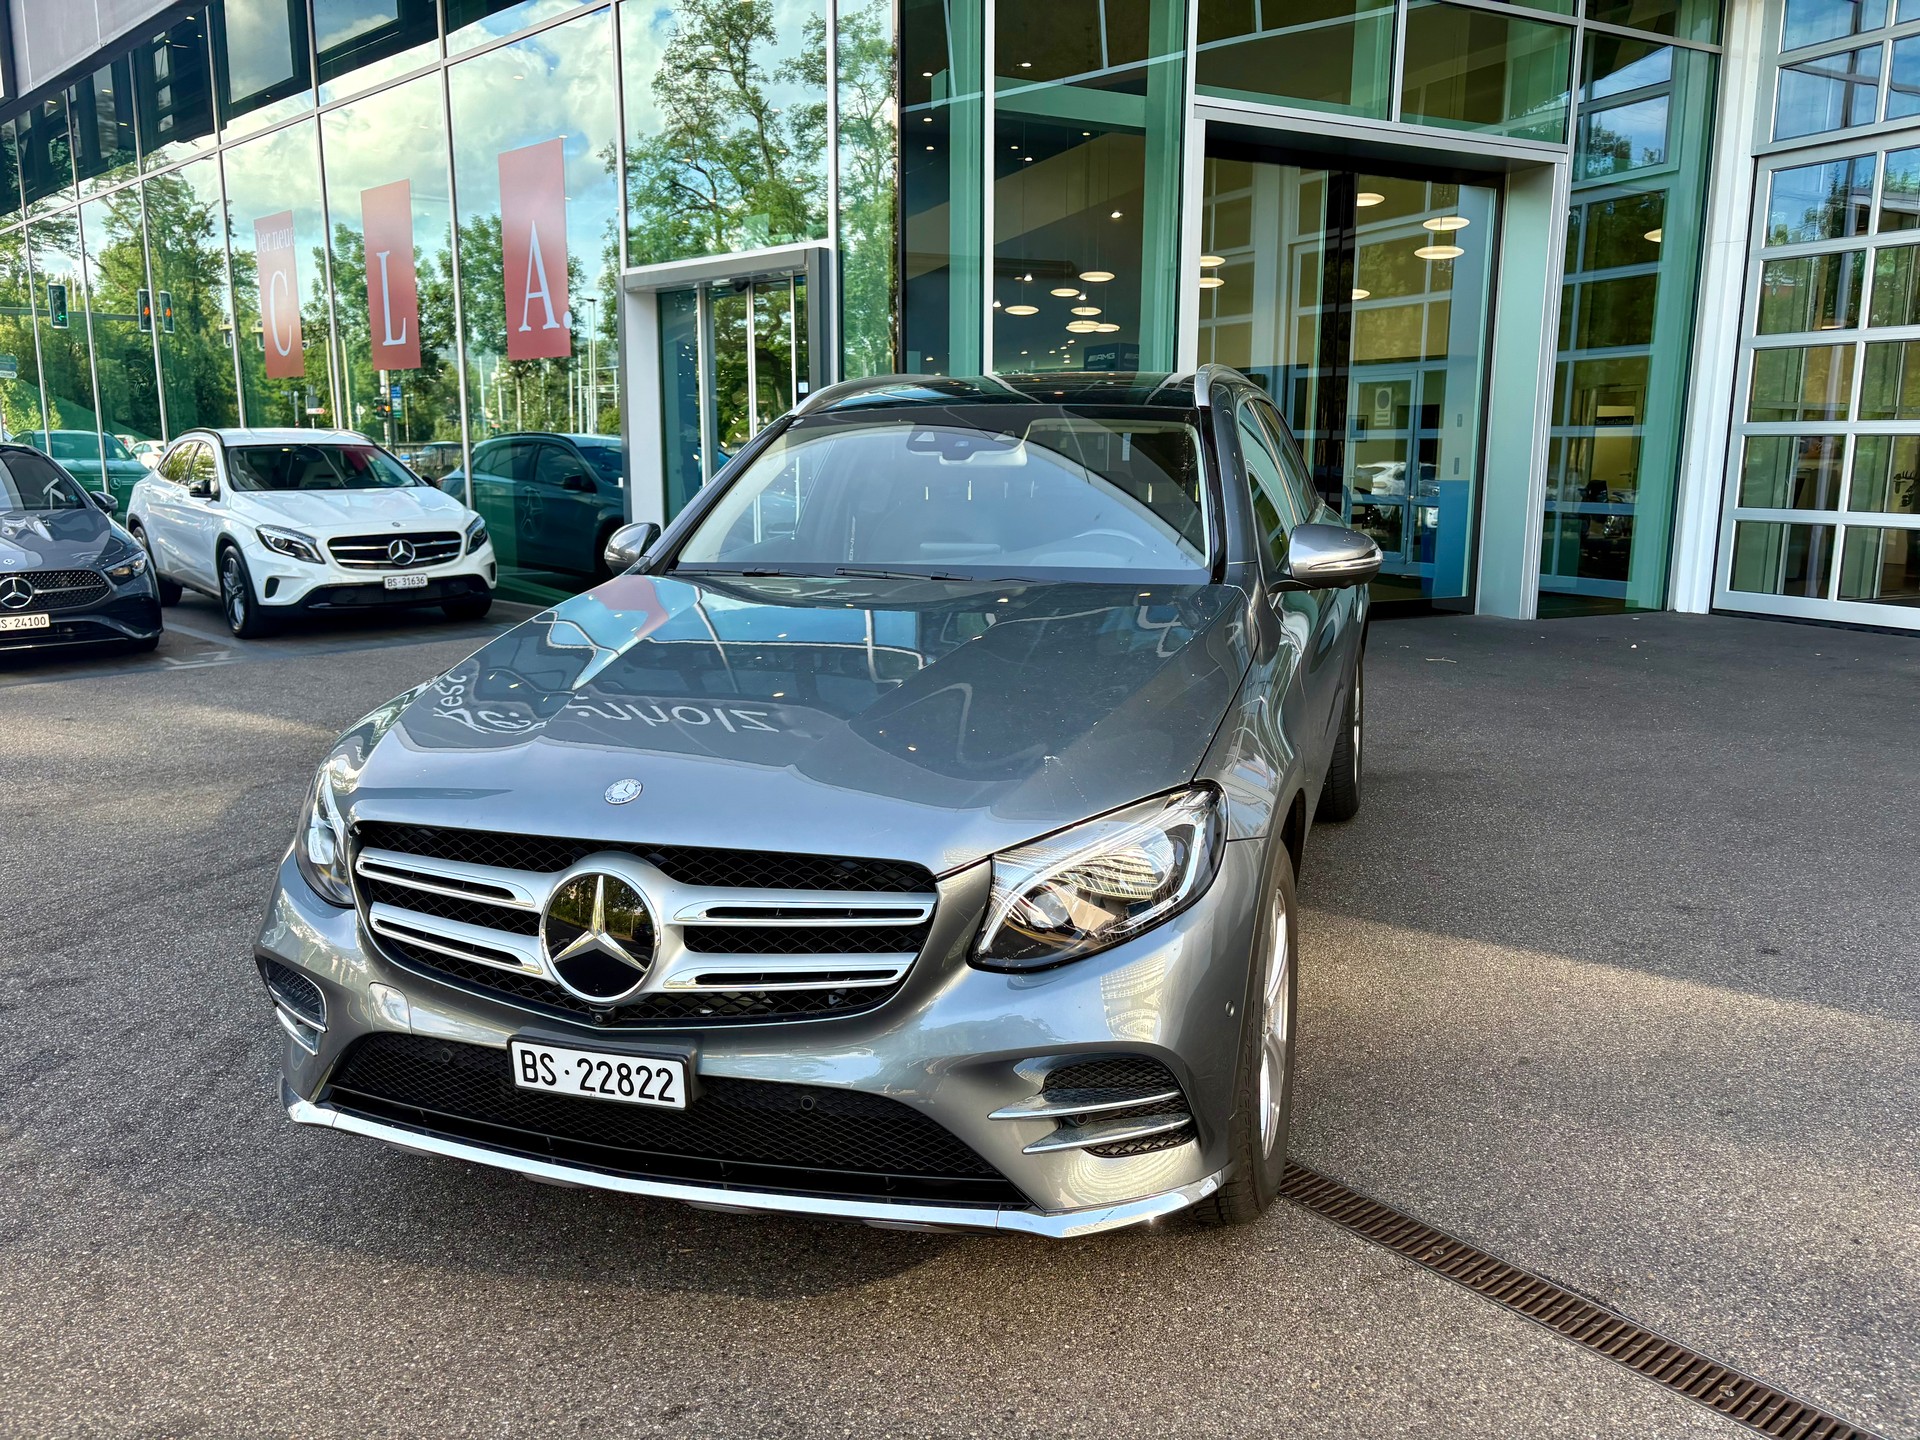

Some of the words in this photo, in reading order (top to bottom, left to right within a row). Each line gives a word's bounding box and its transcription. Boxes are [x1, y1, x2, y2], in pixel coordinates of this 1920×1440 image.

[269, 268, 292, 357] C
[376, 250, 407, 346] L
[0, 616, 47, 629] S·24100
